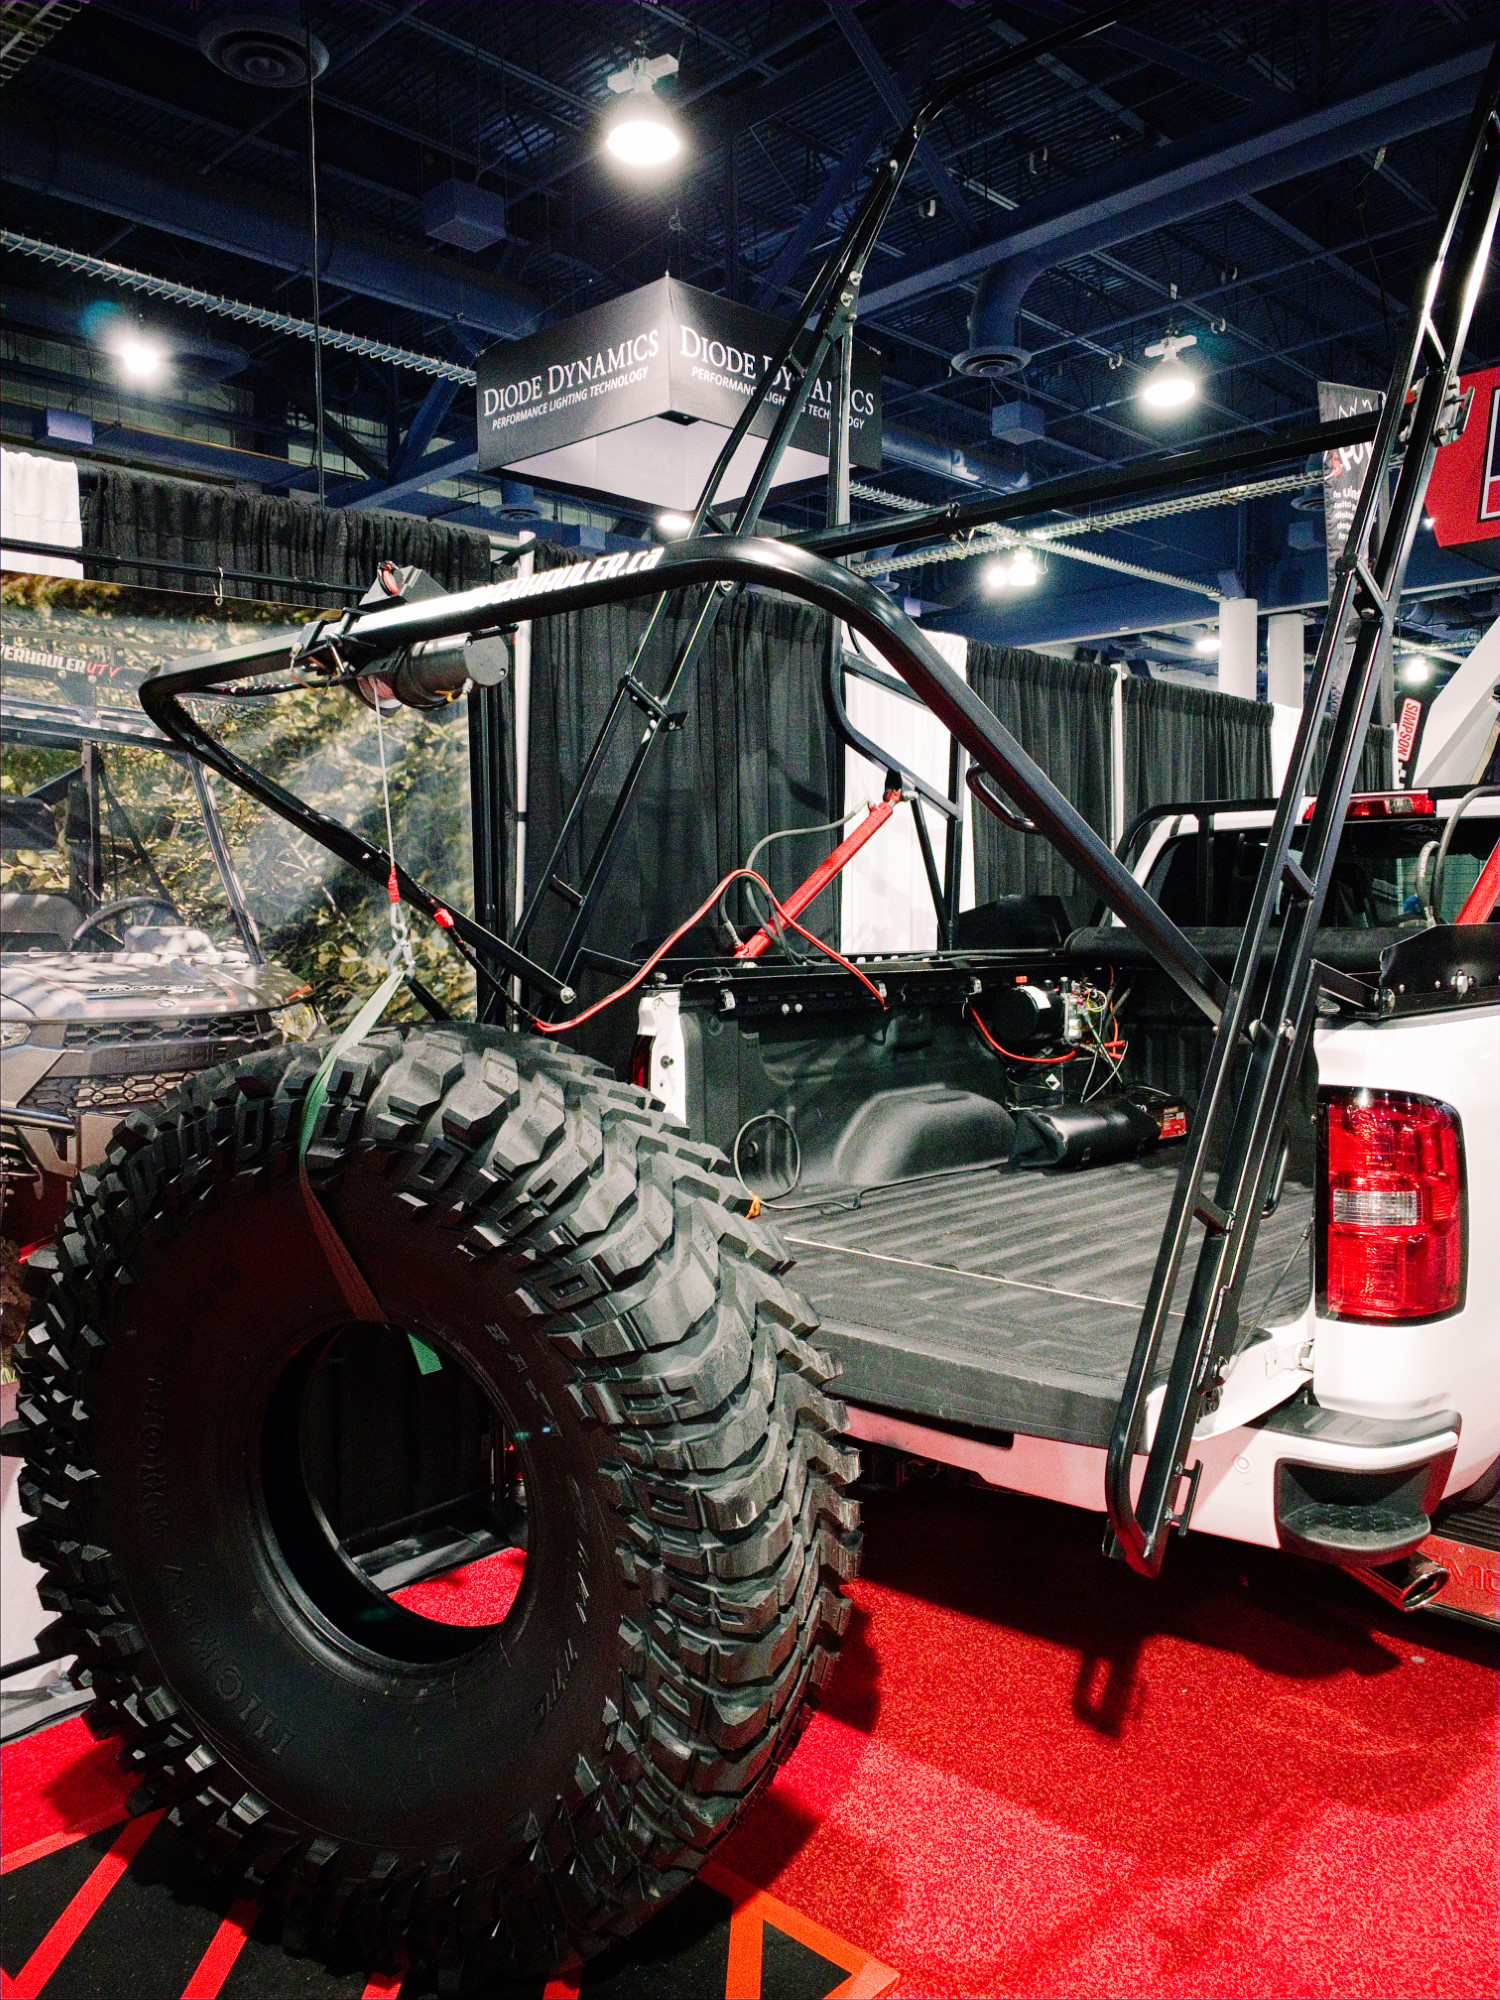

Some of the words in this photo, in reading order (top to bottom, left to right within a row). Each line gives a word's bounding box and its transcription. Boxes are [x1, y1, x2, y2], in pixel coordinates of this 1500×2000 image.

[484, 375, 543, 417] DIODE
[547, 329, 660, 395] DYNAMICS
[492, 402, 548, 430] PERFORMANCE
[548, 388, 588, 412] LIGHTING
[589, 365, 650, 398] TECHNOLOGY
[679, 325, 757, 380] DIODE
[762, 355, 875, 416] DYACS
[691, 366, 758, 397] PERFORMANC
[808, 403, 865, 430] TECHOGY
[1397, 702, 1419, 757] SIMPSON
